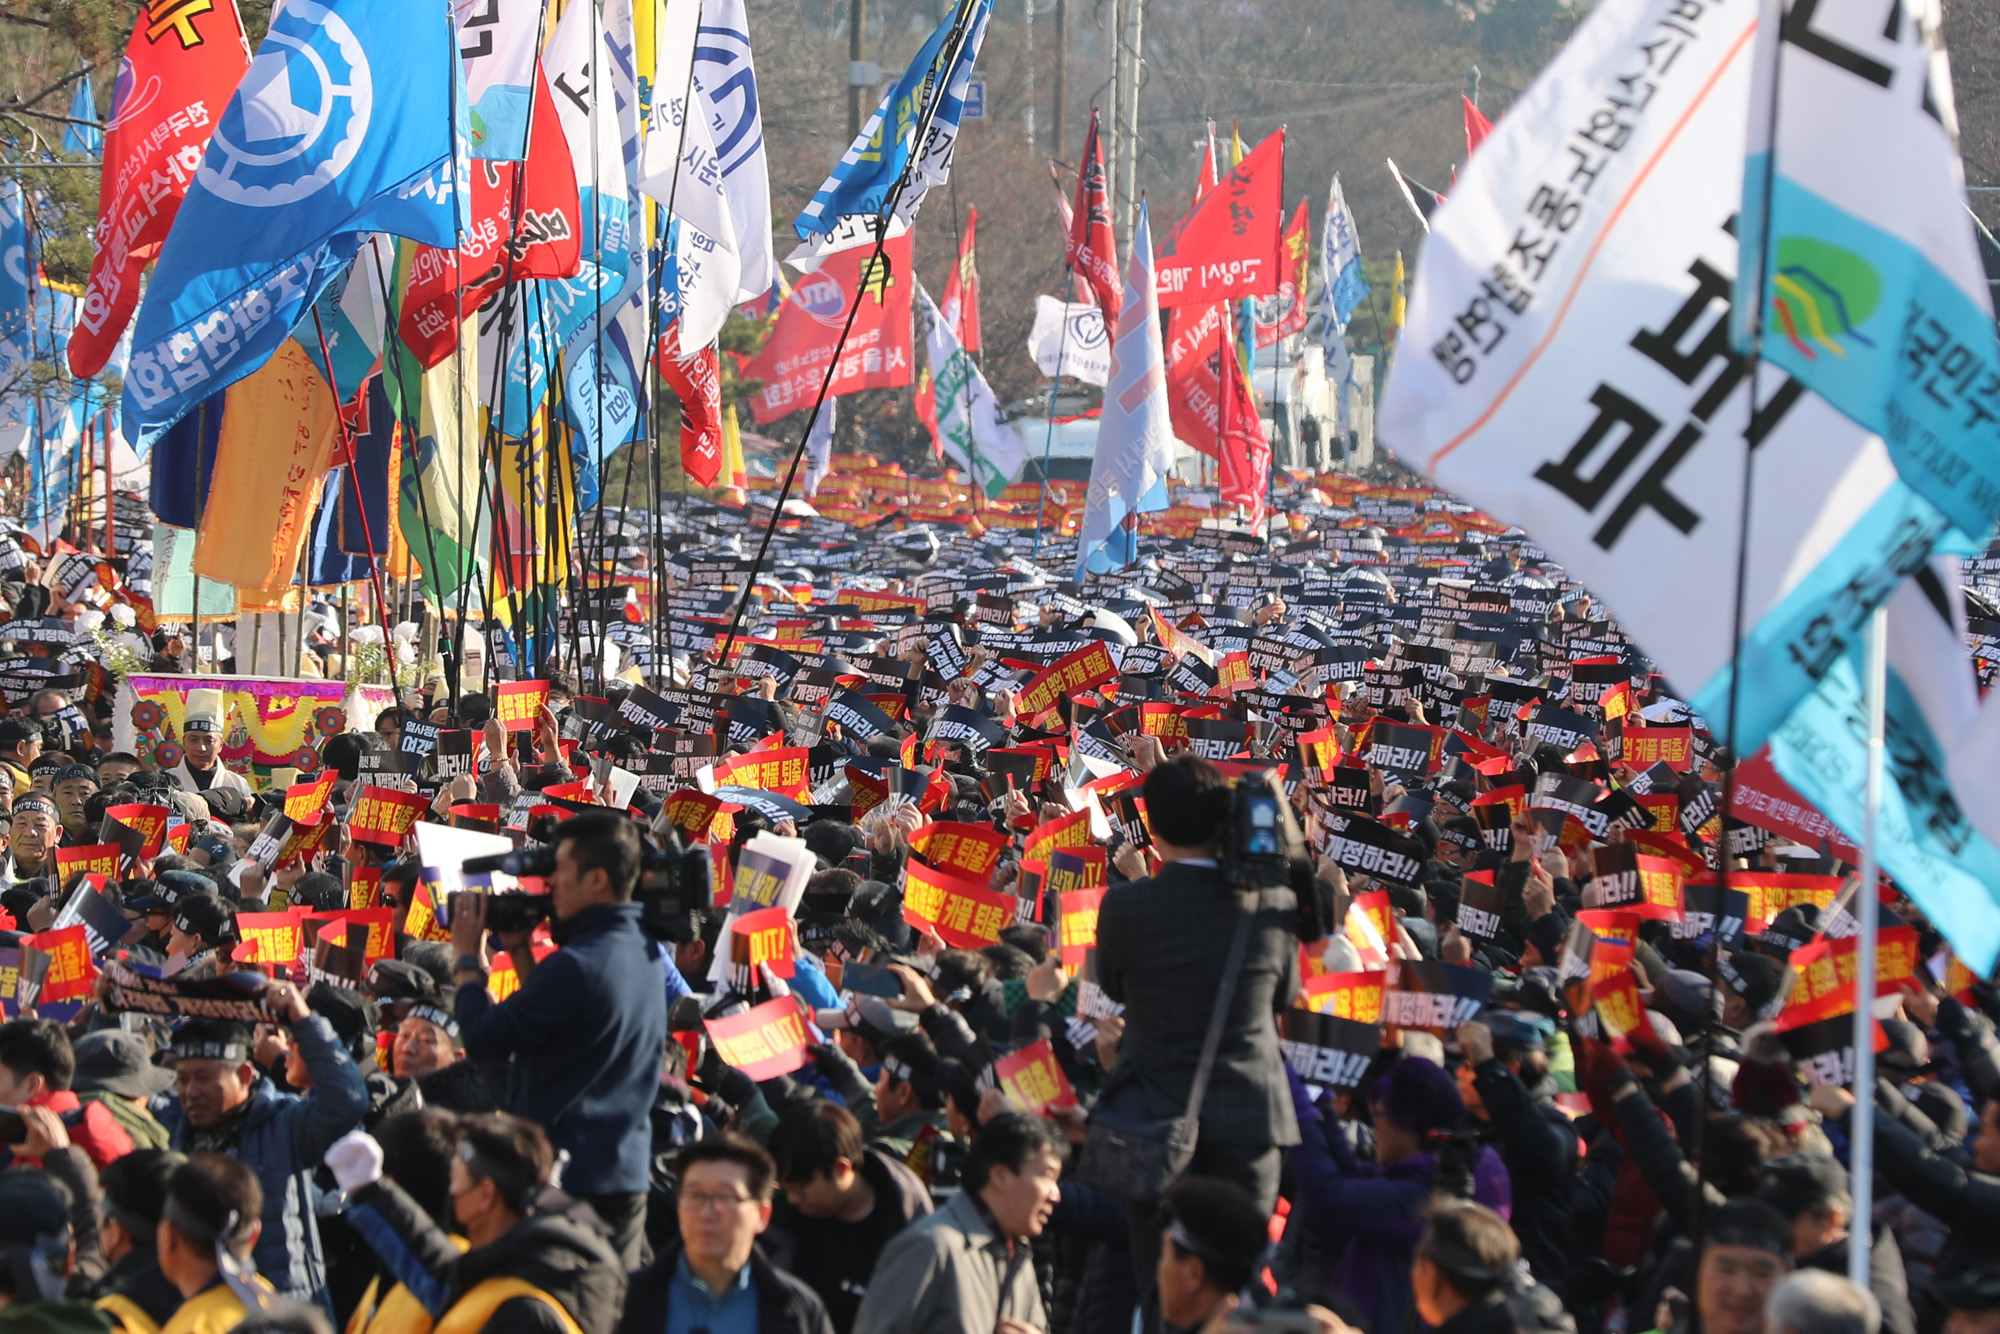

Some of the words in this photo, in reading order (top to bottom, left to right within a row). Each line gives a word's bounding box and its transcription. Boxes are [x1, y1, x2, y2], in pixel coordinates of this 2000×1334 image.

[1046, 670, 1067, 697] 영업
[1063, 660, 1087, 686] 카풀
[1085, 648, 1110, 681] 퇴출!
[1635, 737, 1659, 762] 카풀
[1661, 737, 1690, 763] 퇴출!
[761, 761, 780, 788] 카풀
[781, 757, 809, 786] 퇴출!
[931, 833, 959, 862] 카풀
[954, 837, 999, 874] 퇴출!
[1325, 835, 1421, 883] 개정하라!!
[942, 891, 976, 932] 카풀
[44, 939, 86, 985] 퇴출!
[750, 927, 787, 965] OUT!
[759, 1011, 809, 1057] OUT!
